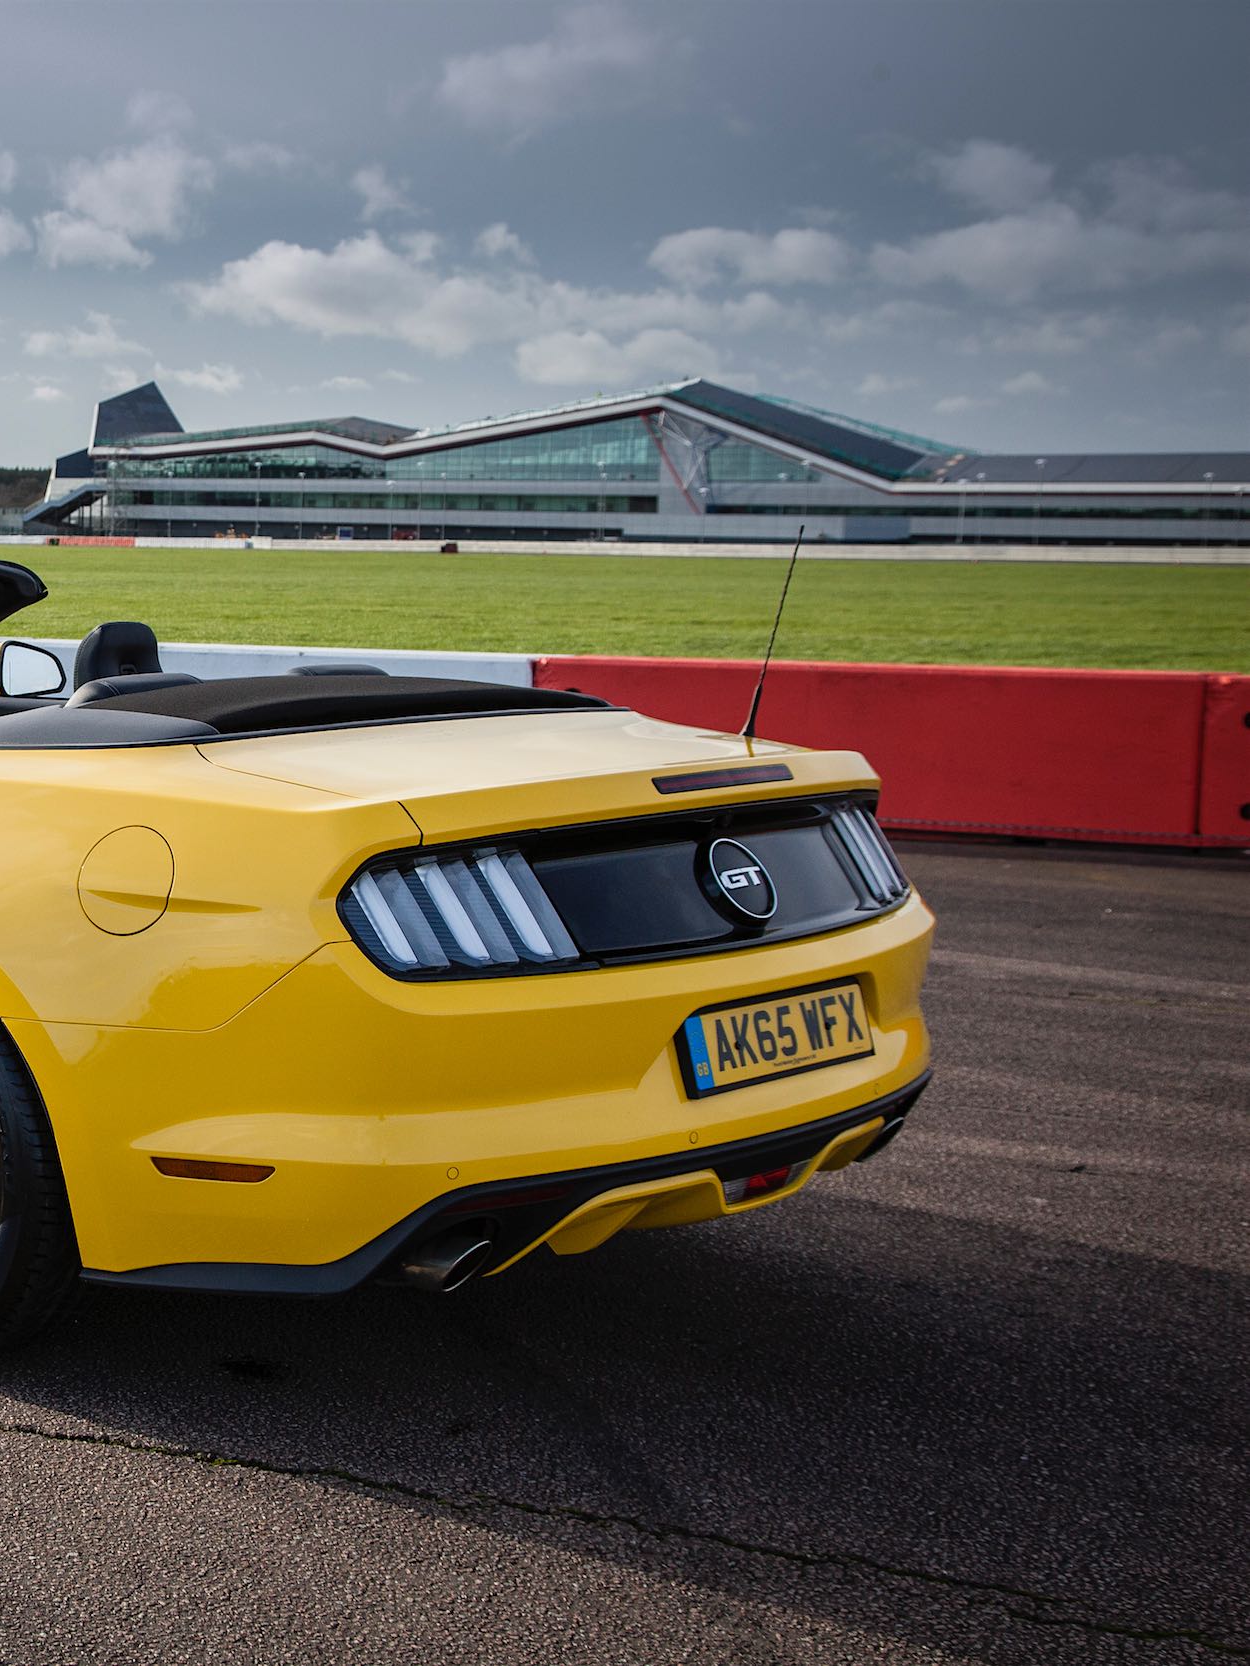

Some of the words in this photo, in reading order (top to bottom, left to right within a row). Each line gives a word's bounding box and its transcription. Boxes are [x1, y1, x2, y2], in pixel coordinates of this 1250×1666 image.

[720, 866, 761, 890] GT
[714, 1005, 798, 1072] AK65
[799, 991, 864, 1051] WFX
[696, 1061, 710, 1078] GB
